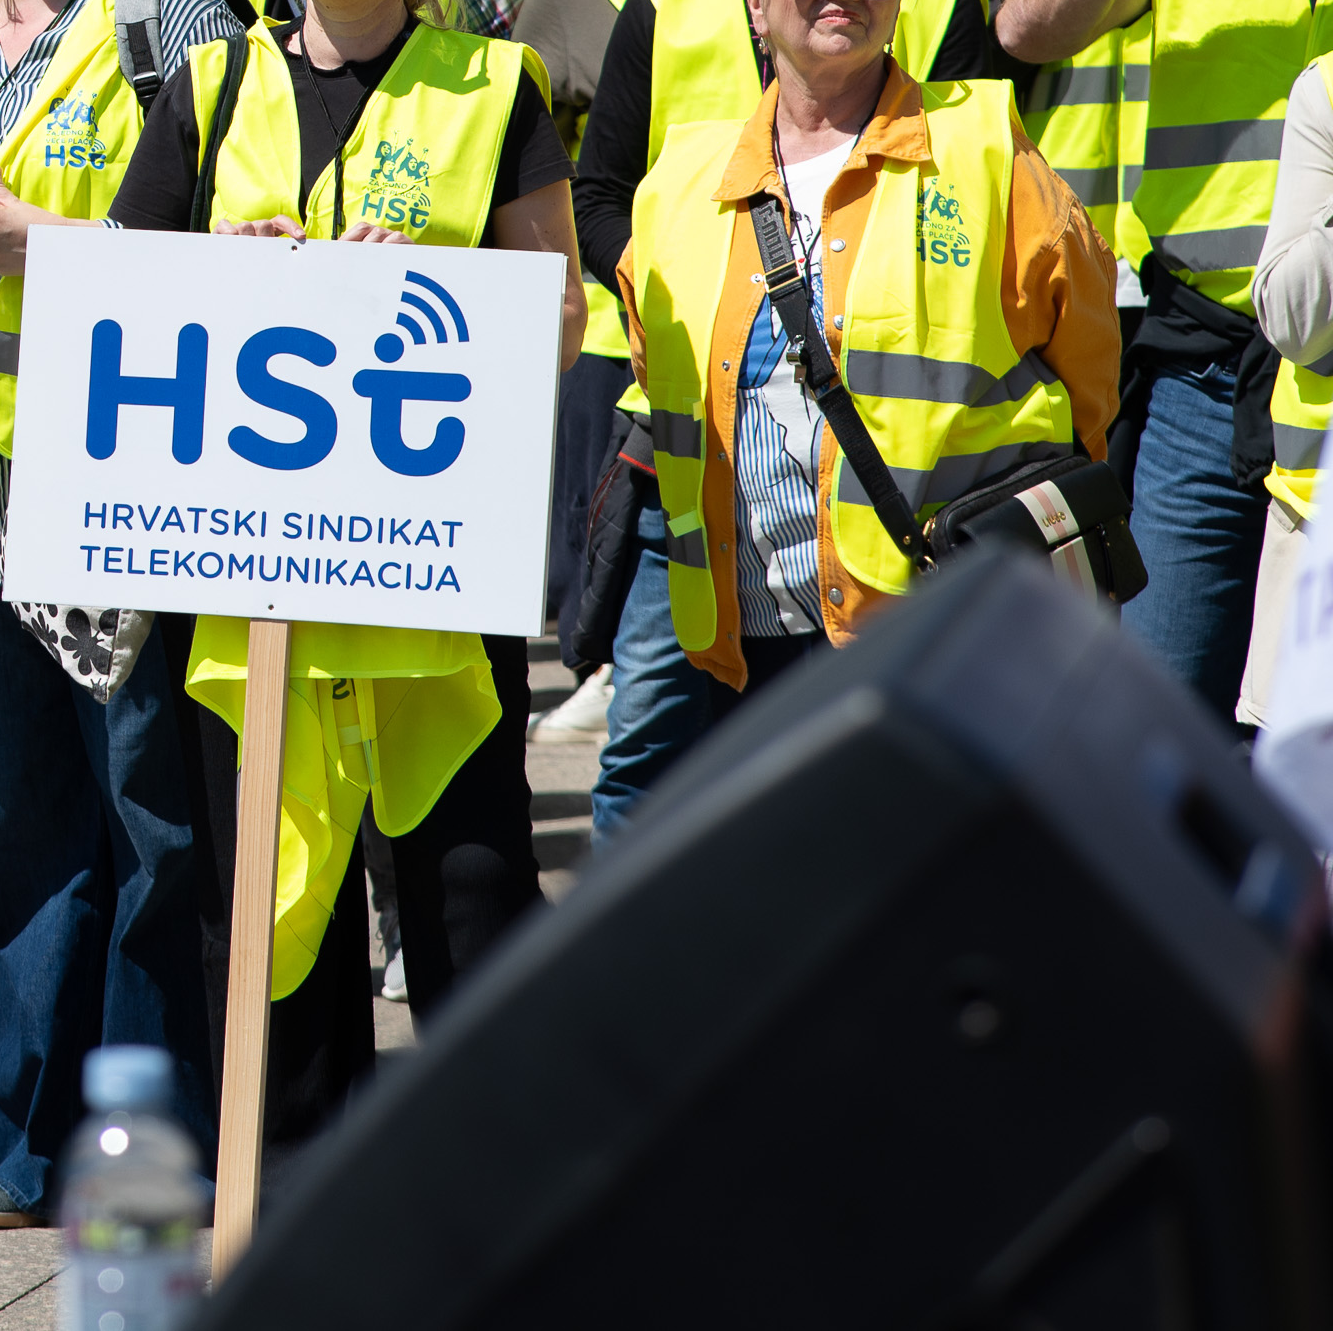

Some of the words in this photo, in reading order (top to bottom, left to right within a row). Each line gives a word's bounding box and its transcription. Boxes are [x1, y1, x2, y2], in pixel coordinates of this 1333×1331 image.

[83, 501, 268, 539] HRVATSKI
[282, 511, 464, 549] SINDIKAT
[79, 544, 461, 593] TELEKOMUNIKACIJA
